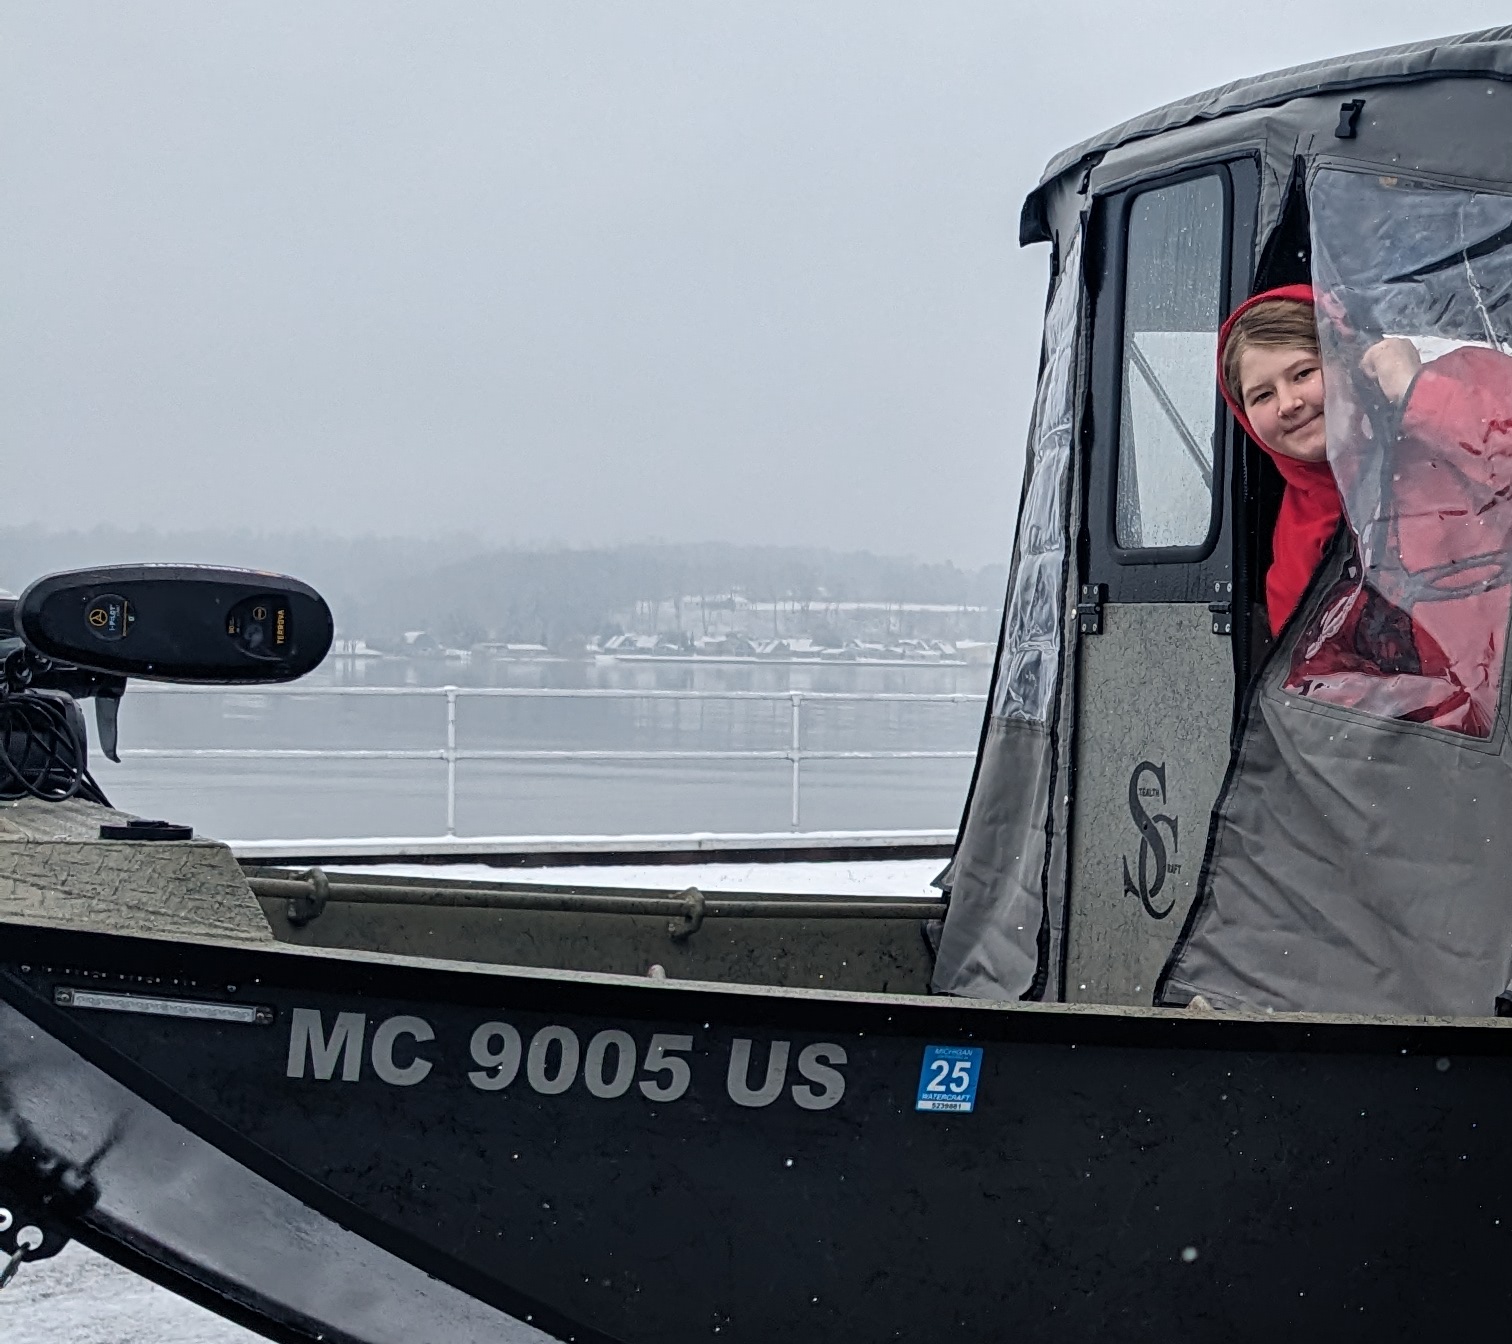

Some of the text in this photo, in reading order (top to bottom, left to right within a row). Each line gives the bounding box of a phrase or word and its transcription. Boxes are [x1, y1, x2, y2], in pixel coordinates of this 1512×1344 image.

[286, 1007, 848, 1110] MC 9005 US
[935, 1048, 973, 1056] MICHIGAN
[926, 1060, 972, 1093] 25
[921, 1093, 971, 1101] WATERCRAFT
